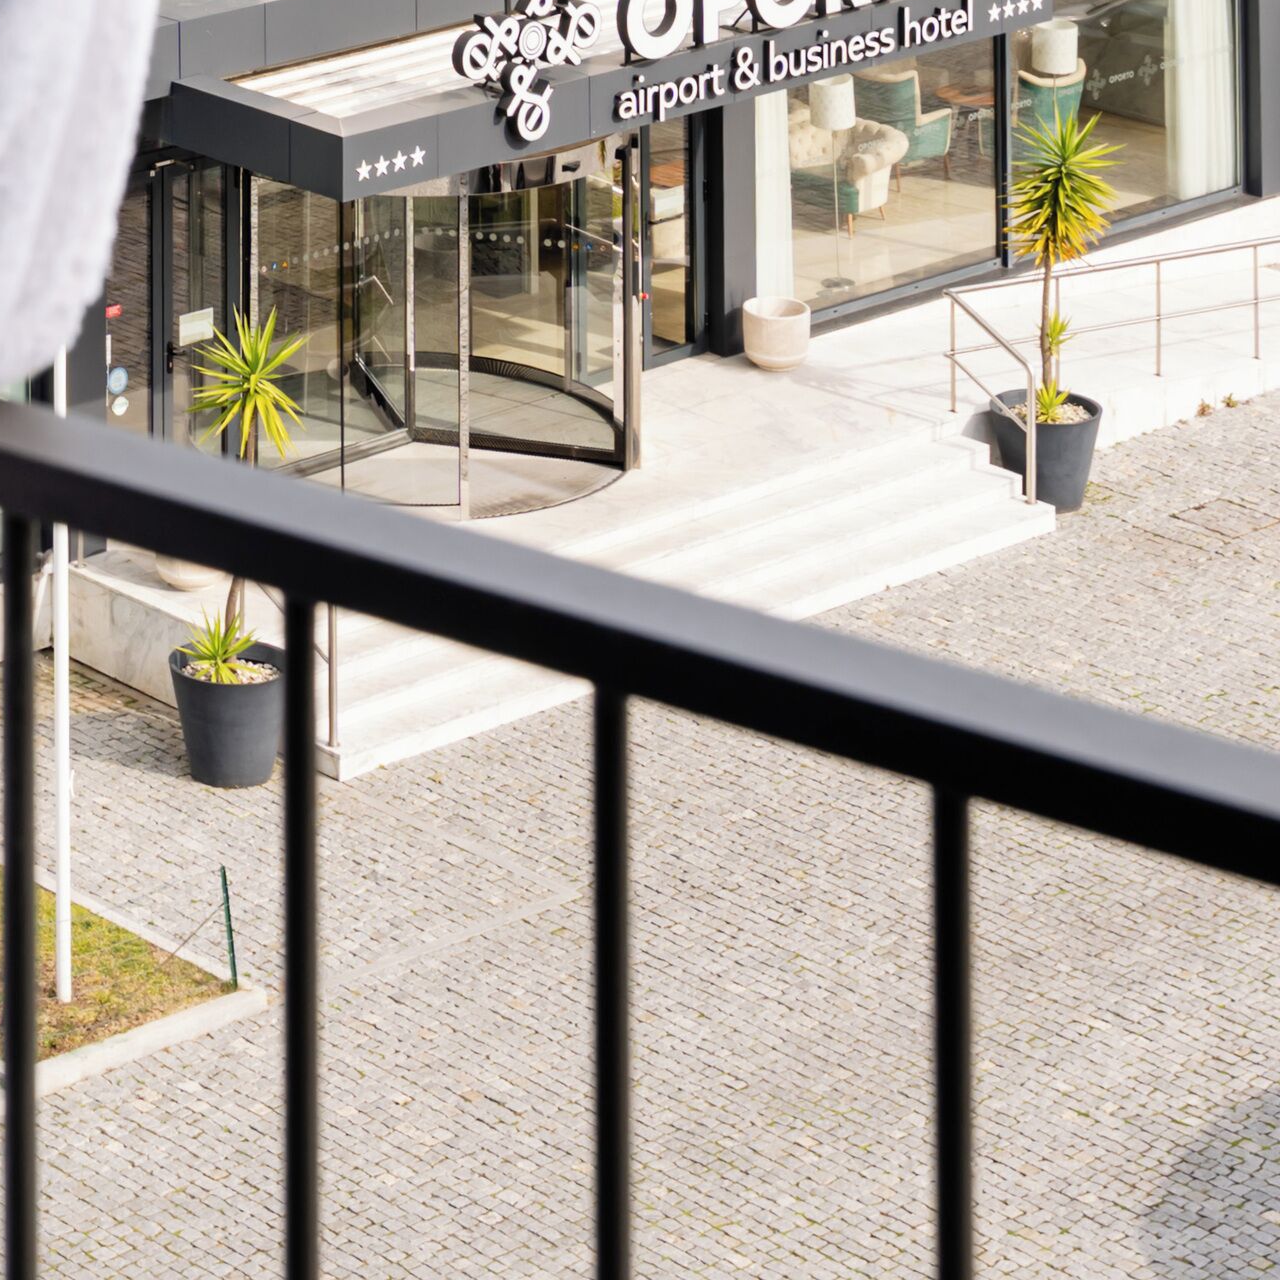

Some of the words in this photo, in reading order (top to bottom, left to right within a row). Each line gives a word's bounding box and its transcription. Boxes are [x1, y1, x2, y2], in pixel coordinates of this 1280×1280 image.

[618, 63, 725, 122] airport
[733, 46, 762, 91] &
[769, 26, 896, 83] business
[1108, 70, 1134, 83] OPORTO
